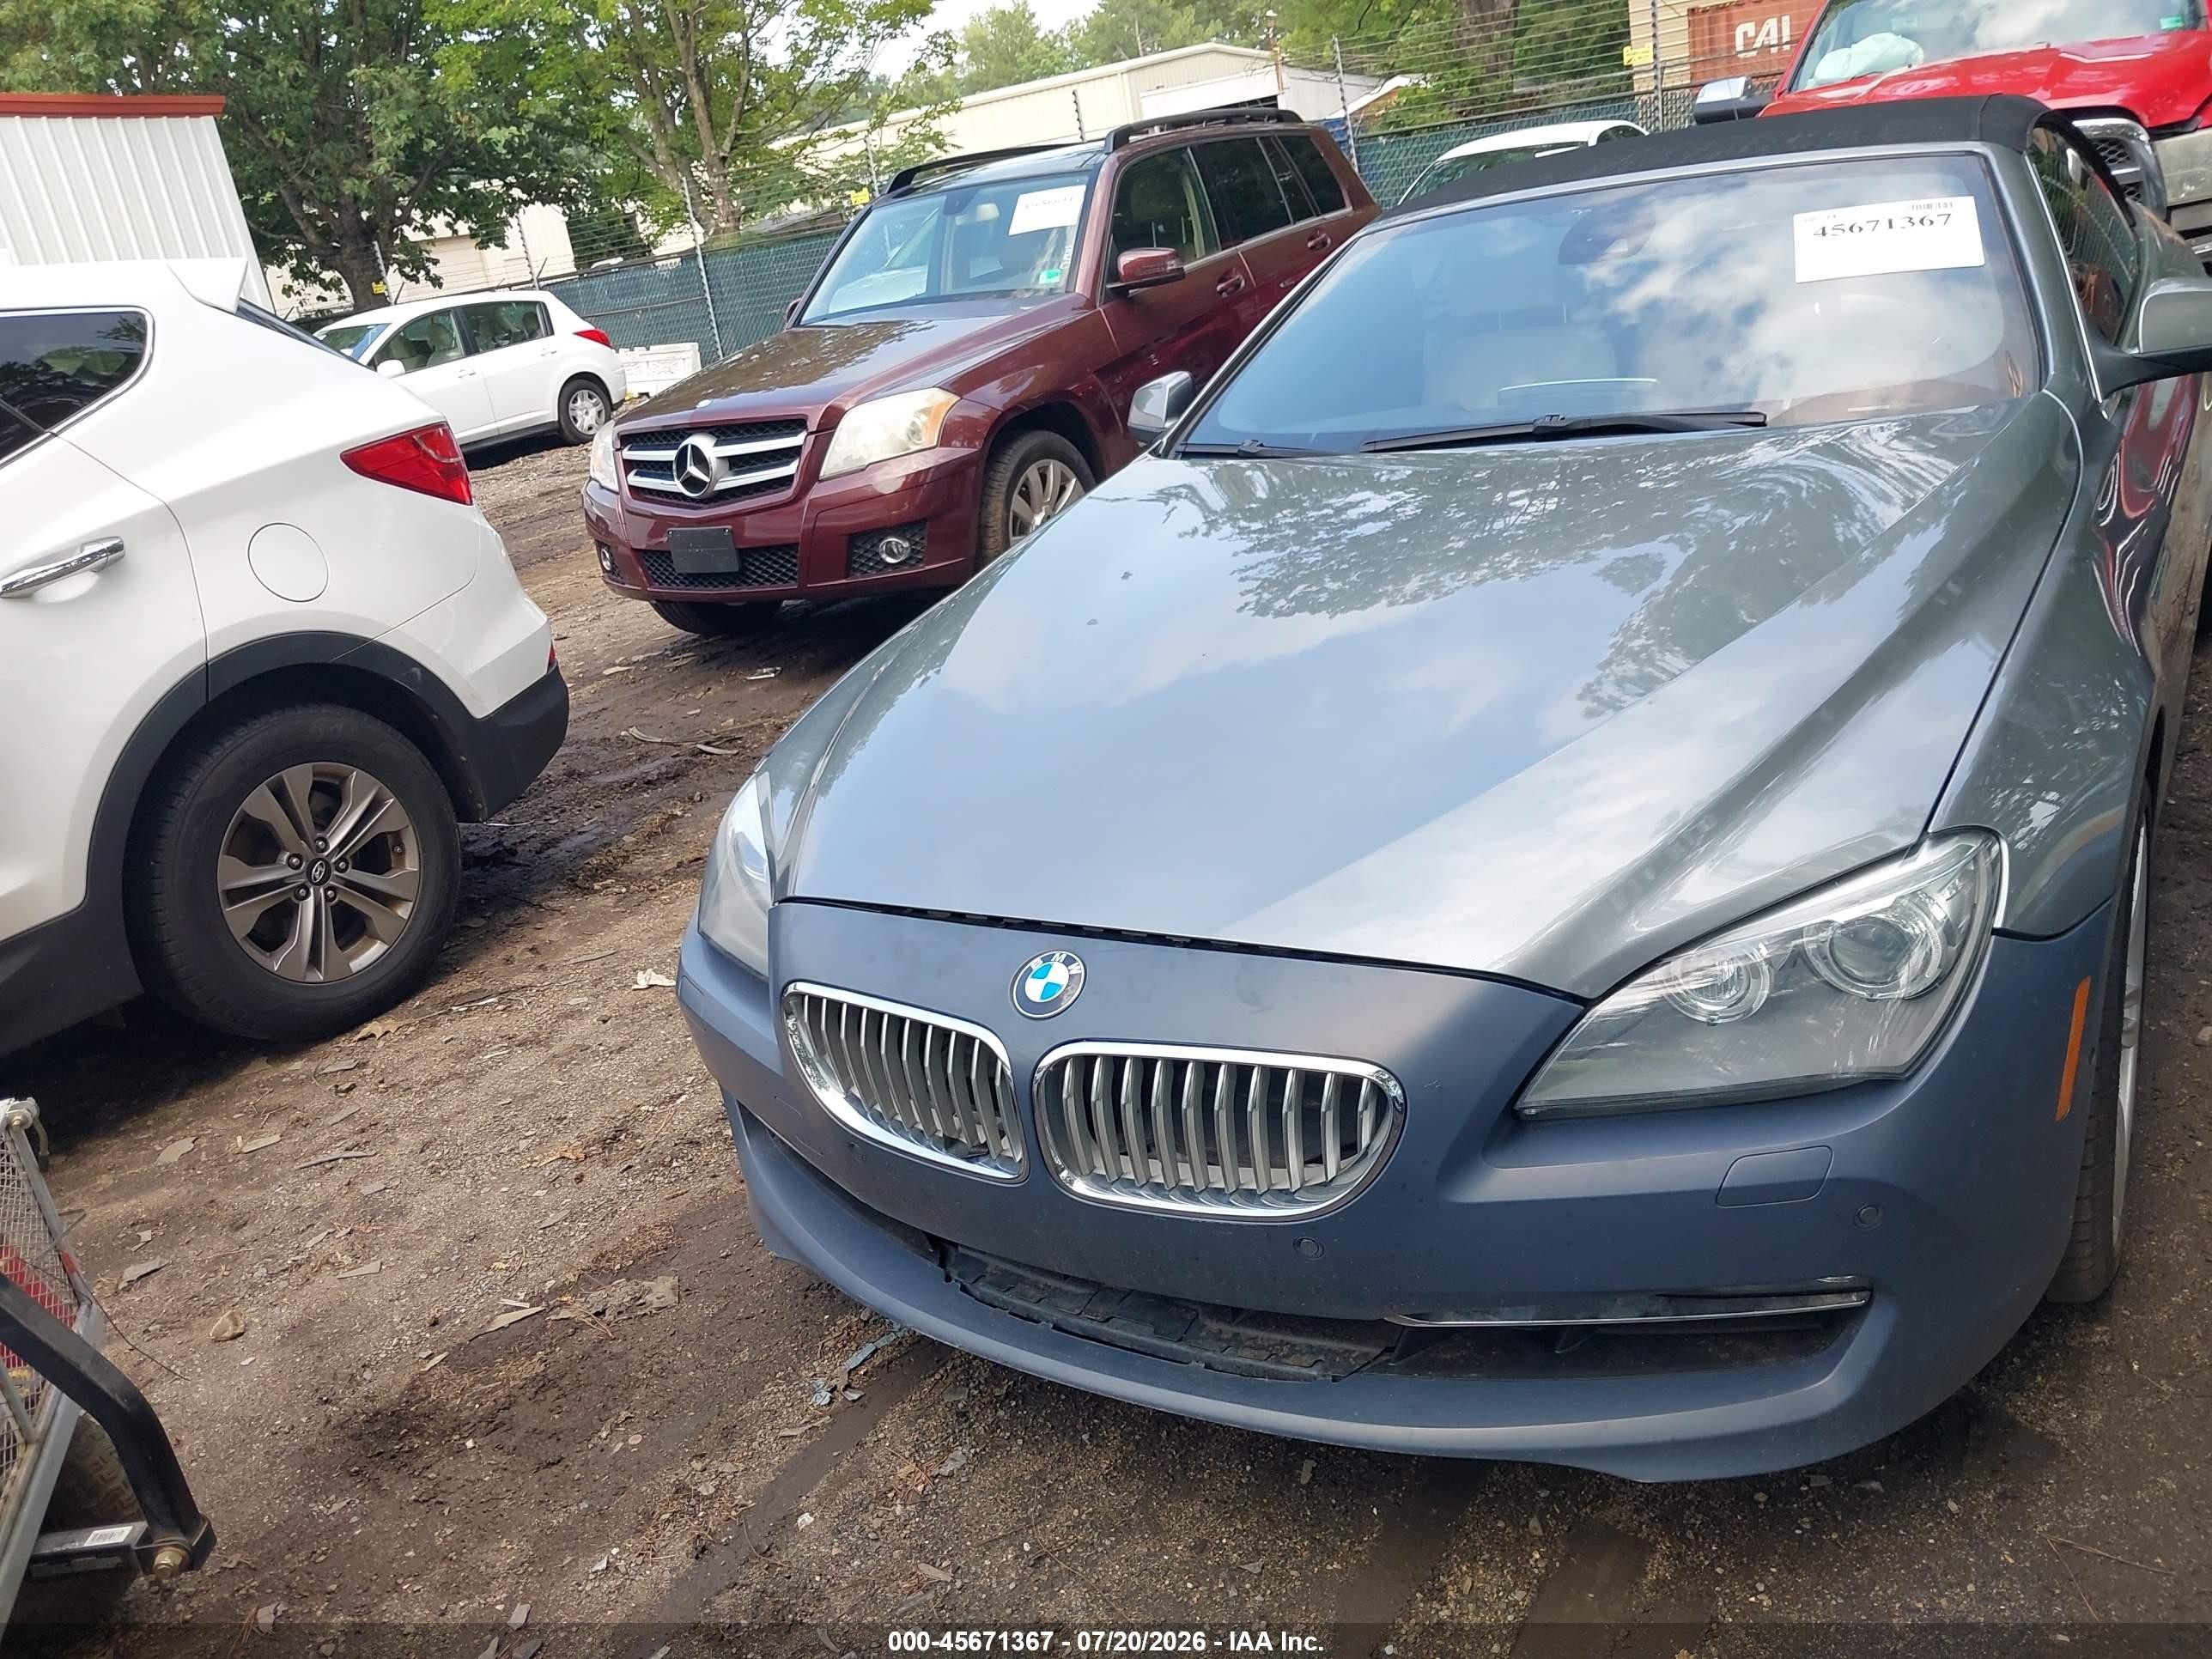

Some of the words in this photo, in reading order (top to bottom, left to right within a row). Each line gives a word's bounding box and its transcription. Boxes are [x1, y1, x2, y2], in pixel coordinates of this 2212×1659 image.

[1735, 14, 1791, 58] CAI
[1813, 212, 1952, 238] 45671367
[1030, 952, 1082, 975] BMW
